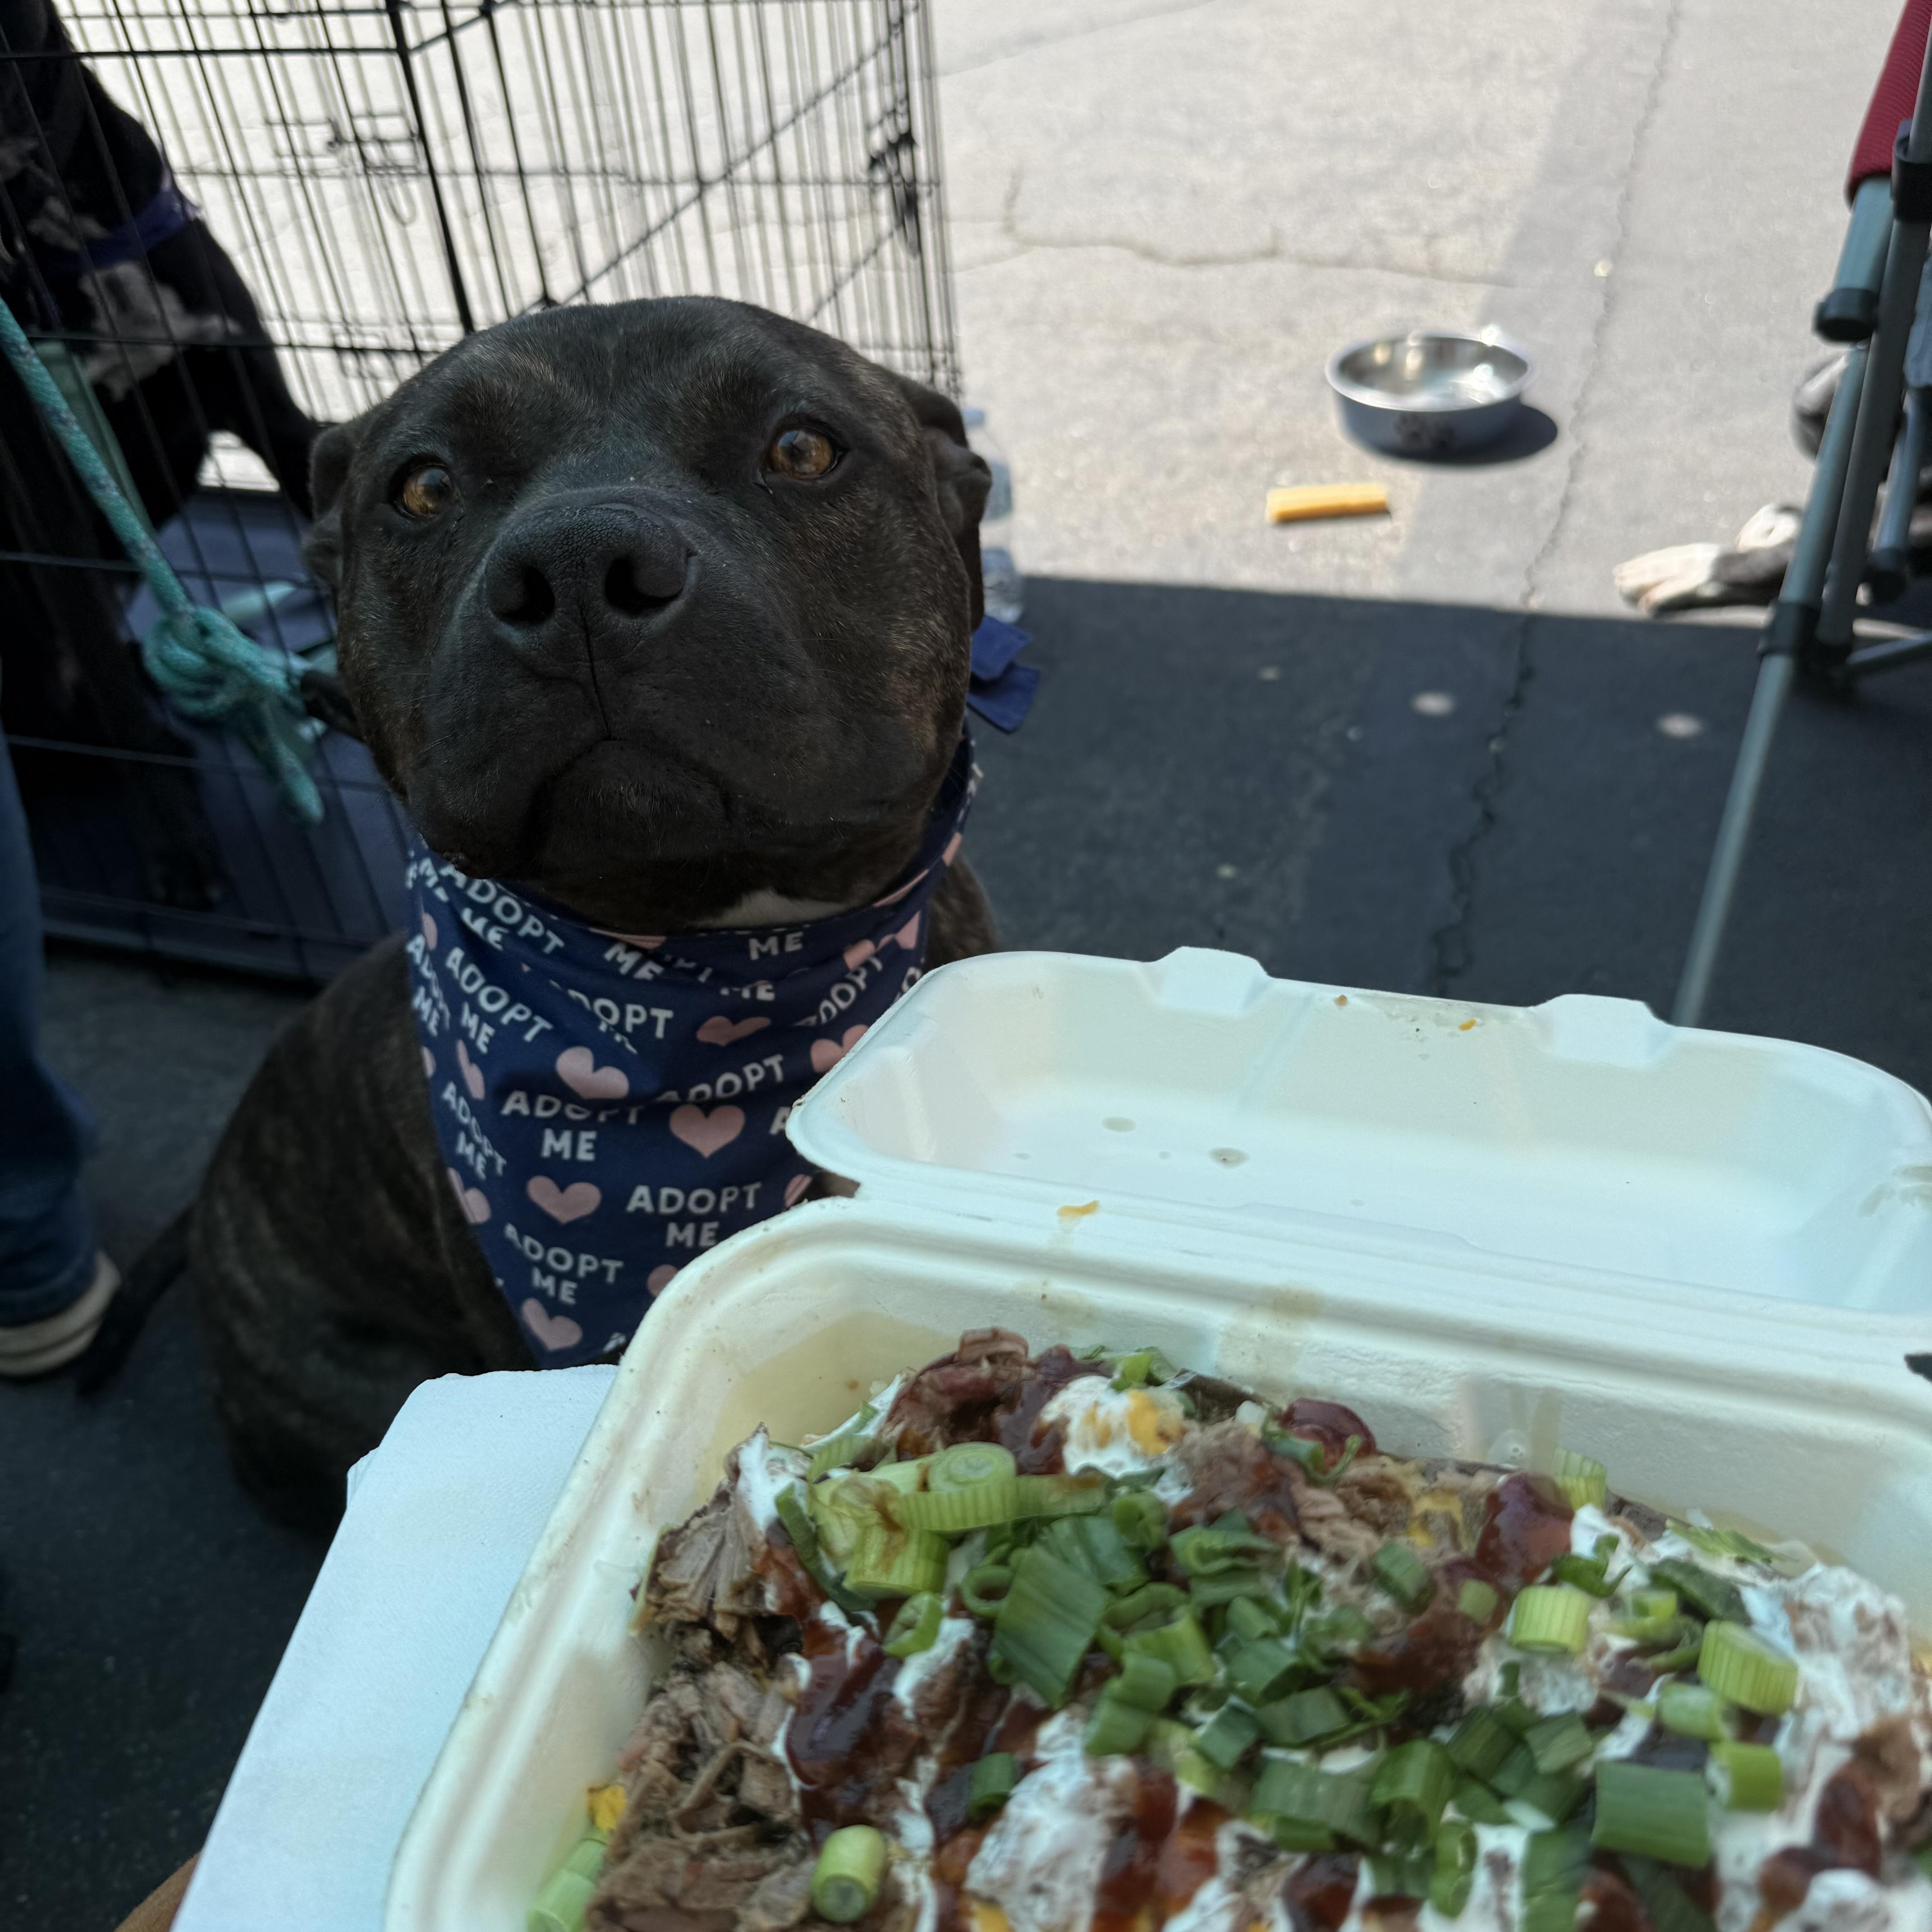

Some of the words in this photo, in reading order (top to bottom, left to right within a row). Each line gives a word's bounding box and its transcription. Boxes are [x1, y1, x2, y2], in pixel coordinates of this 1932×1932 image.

[749, 931, 804, 961] ME
[411, 986, 440, 1037] ME
[445, 947, 554, 1043] ADOPT
[549, 979, 674, 1039] OPT
[460, 1002, 495, 1054] ME
[456, 1131, 487, 1180] ME
[542, 1128, 598, 1162] ME
[626, 1182, 762, 1214] ADOPT
[504, 1223, 625, 1284] ADOPT
[665, 1221, 719, 1248] ME
[531, 1266, 578, 1305] ME
